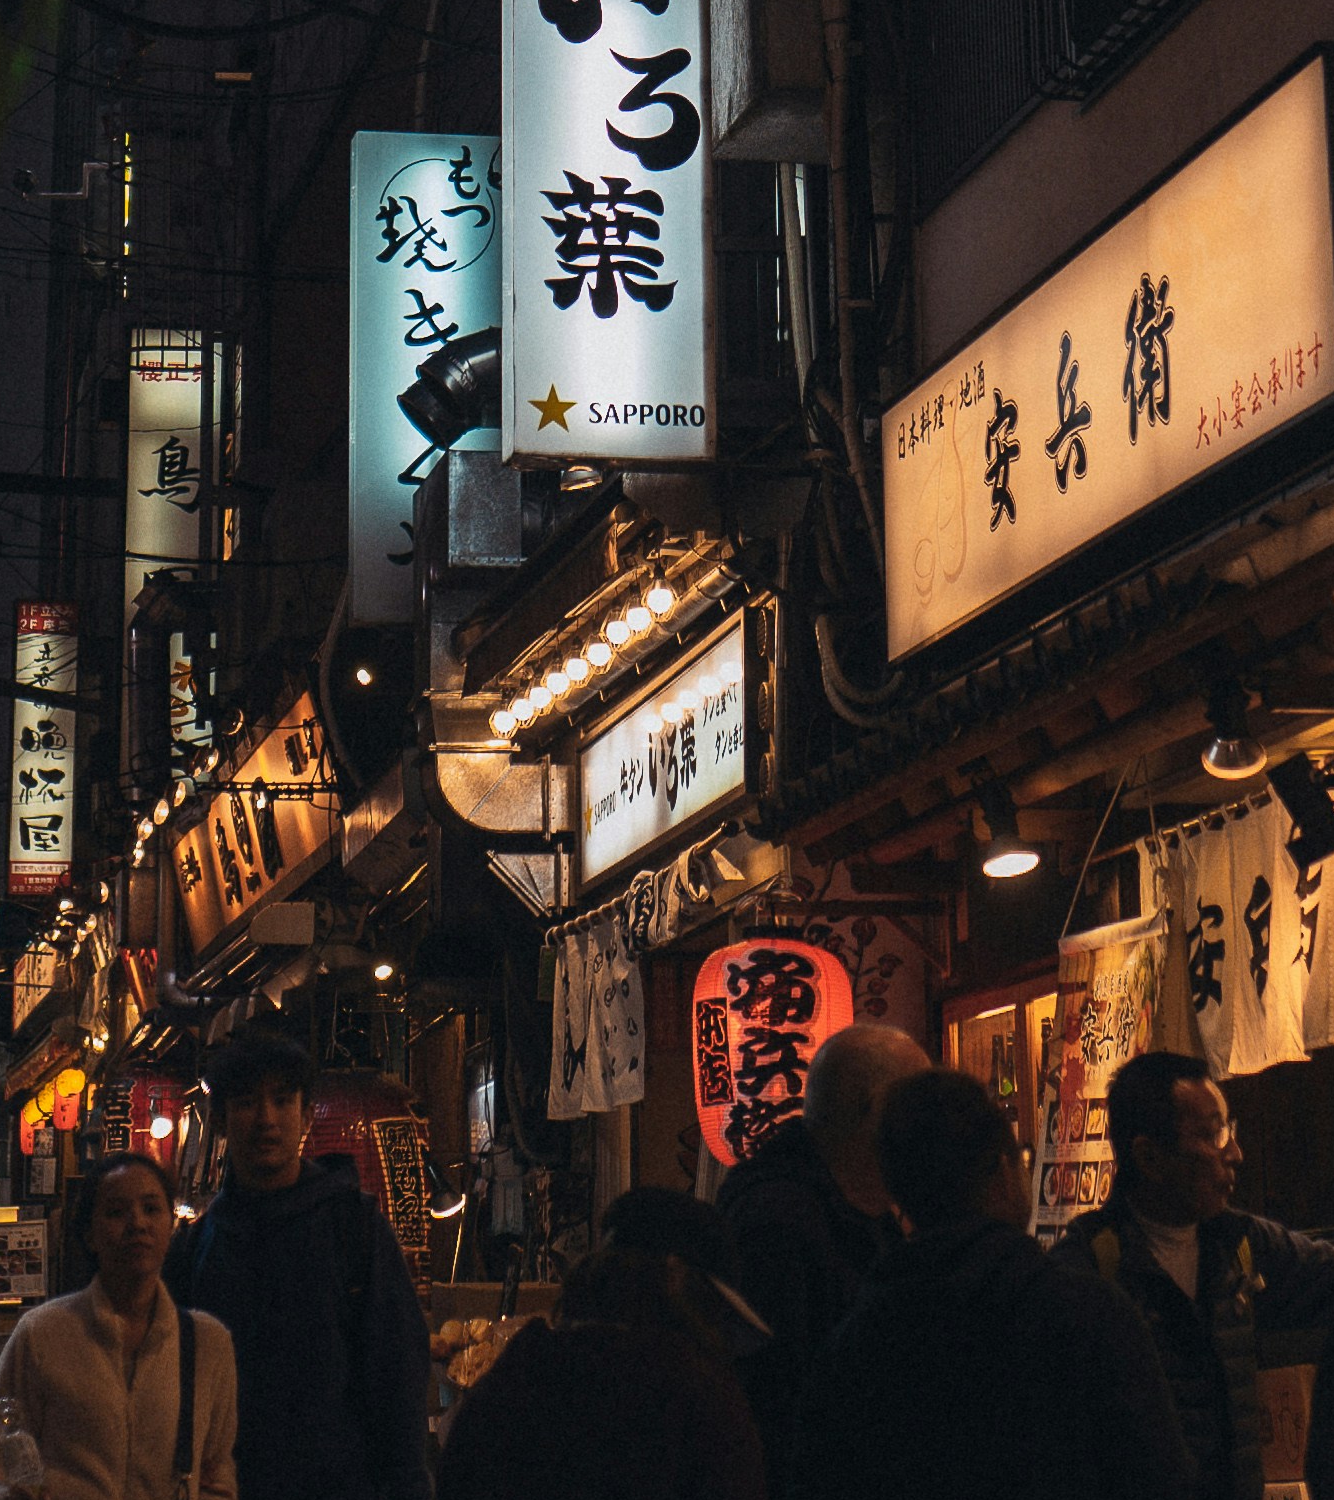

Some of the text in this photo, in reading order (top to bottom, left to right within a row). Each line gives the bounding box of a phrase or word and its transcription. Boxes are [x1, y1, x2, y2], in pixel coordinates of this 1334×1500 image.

[441, 144, 492, 228] もつ
[588, 400, 706, 428] SAPPORO
[898, 360, 985, 460] 日本料理・地酒
[984, 272, 1174, 533] 安兵衛
[1195, 330, 1324, 450] 大小宴会承ります
[19, 719, 68, 852] 晩杯屋
[619, 756, 645, 804] 牛タン
[647, 707, 698, 812] いろ葉
